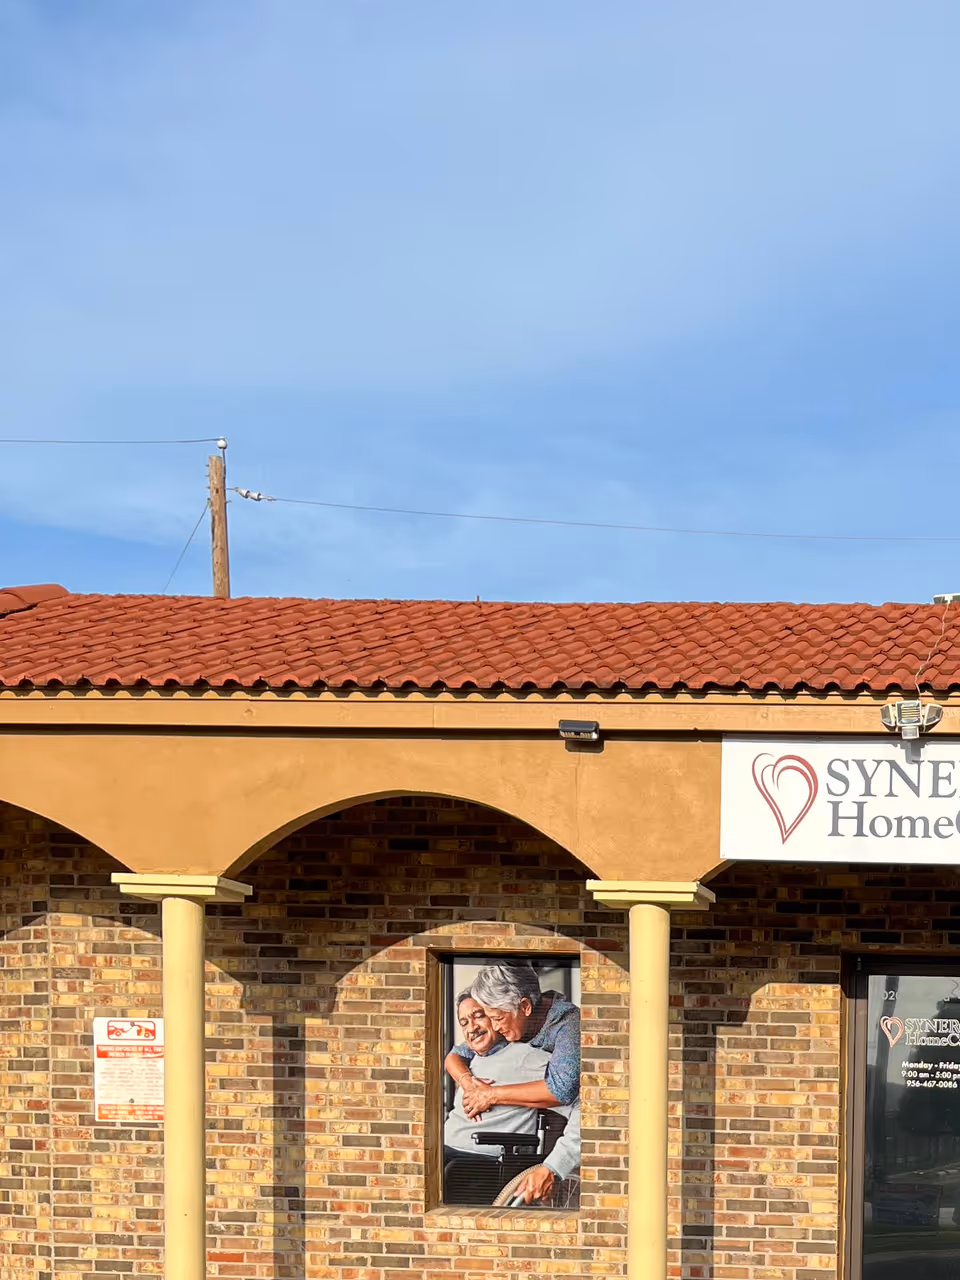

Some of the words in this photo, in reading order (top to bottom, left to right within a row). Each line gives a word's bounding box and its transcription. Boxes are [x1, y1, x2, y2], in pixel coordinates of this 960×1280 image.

[901, 1061, 933, 1071] Monday
[901, 1070, 918, 1078] 9:00
[935, 1071, 952, 1079] 5:00
[906, 1080, 958, 1089] 956-467-0086
